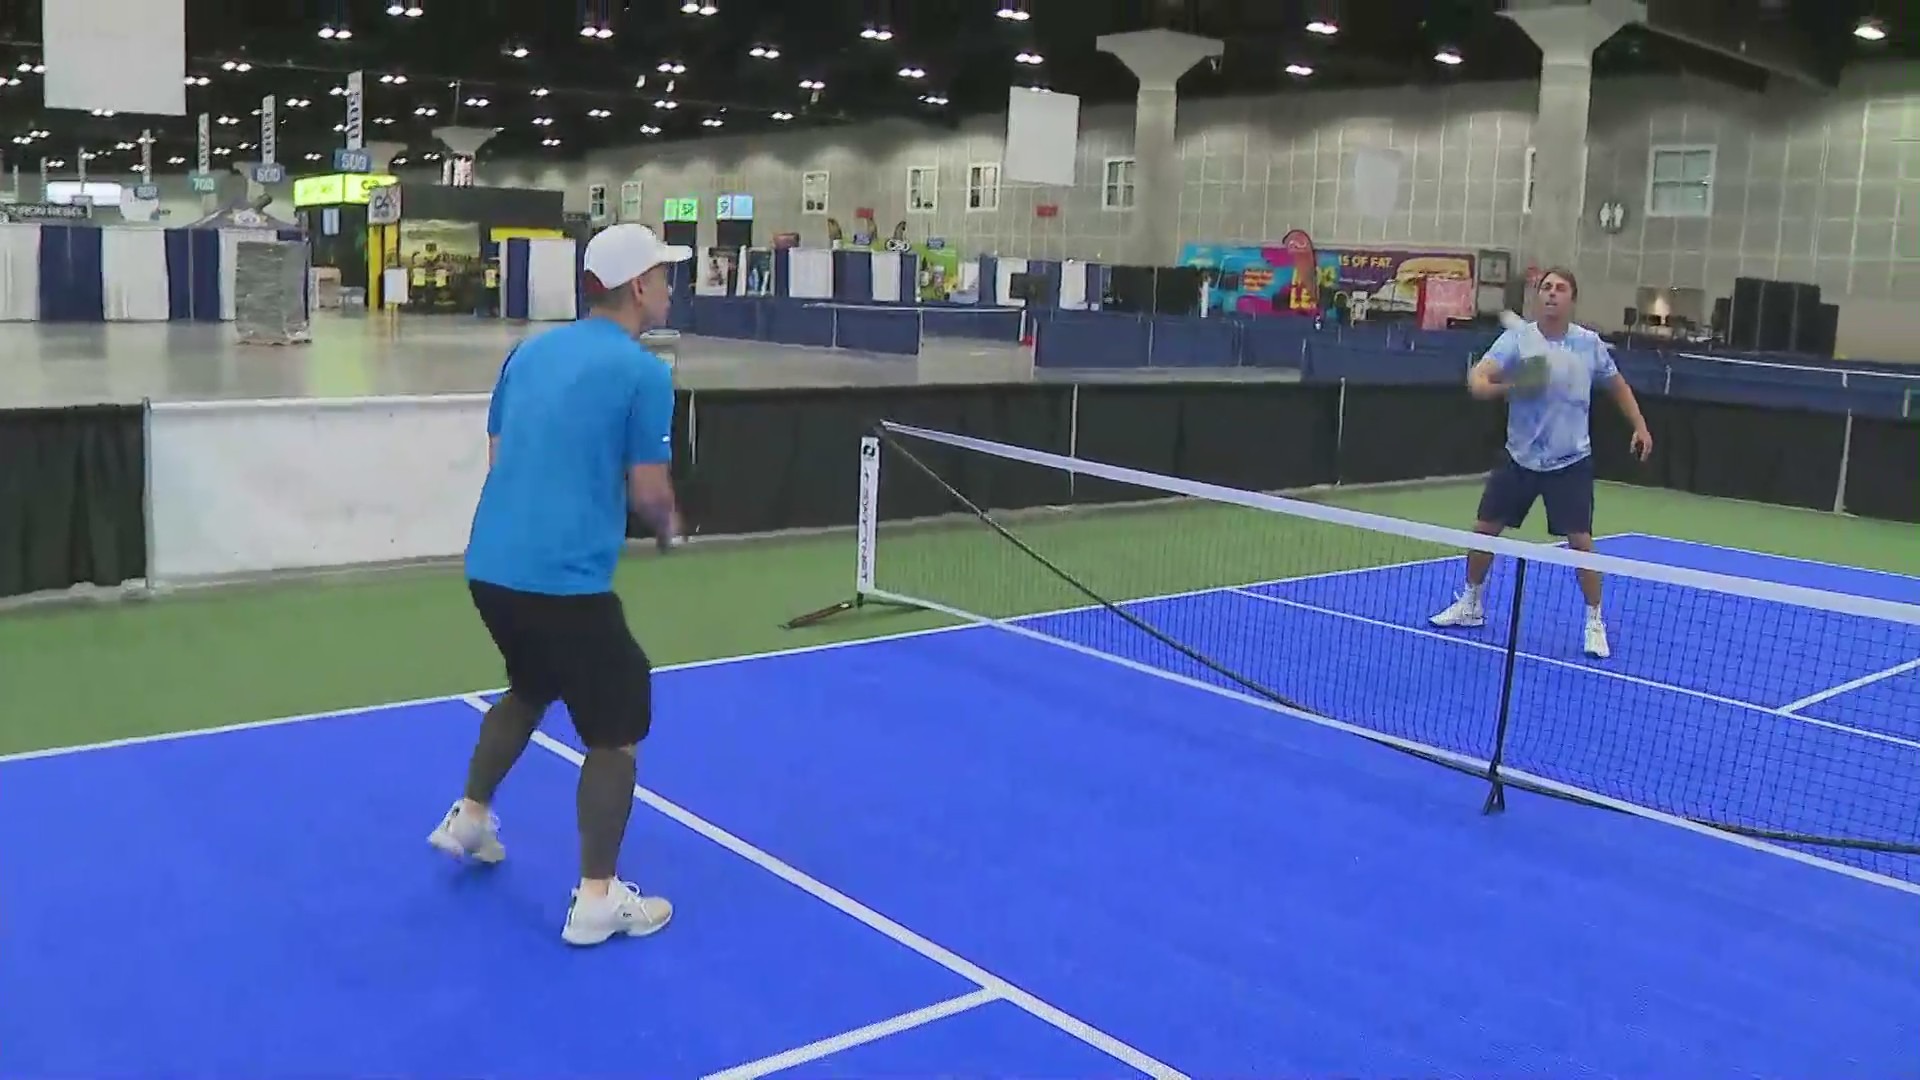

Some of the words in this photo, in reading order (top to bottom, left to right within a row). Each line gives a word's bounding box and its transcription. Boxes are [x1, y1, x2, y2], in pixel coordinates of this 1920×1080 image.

[341, 152, 367, 170] 500
[257, 168, 281, 182] 600
[1351, 255, 1369, 268] OF
